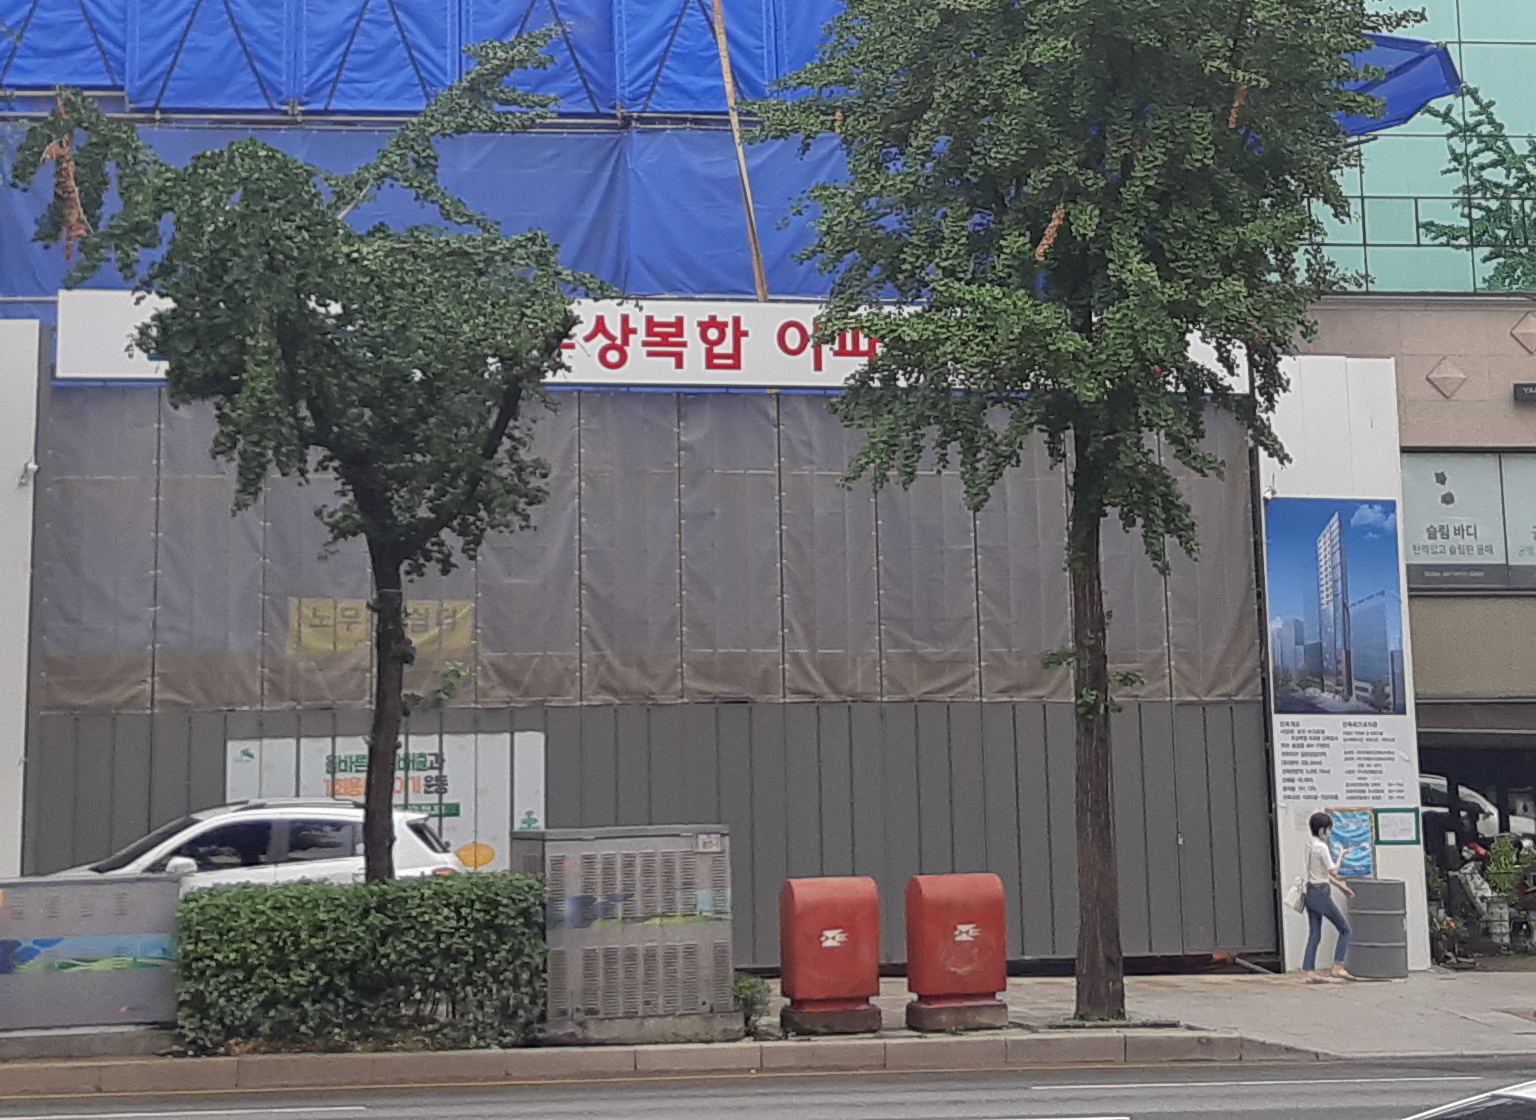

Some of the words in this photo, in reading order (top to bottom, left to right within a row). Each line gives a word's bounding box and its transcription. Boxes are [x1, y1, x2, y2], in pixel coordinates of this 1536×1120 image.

[561, 313, 750, 371] 상복합
[1425, 523, 1450, 540] 슬림
[1453, 523, 1478, 540] 바디
